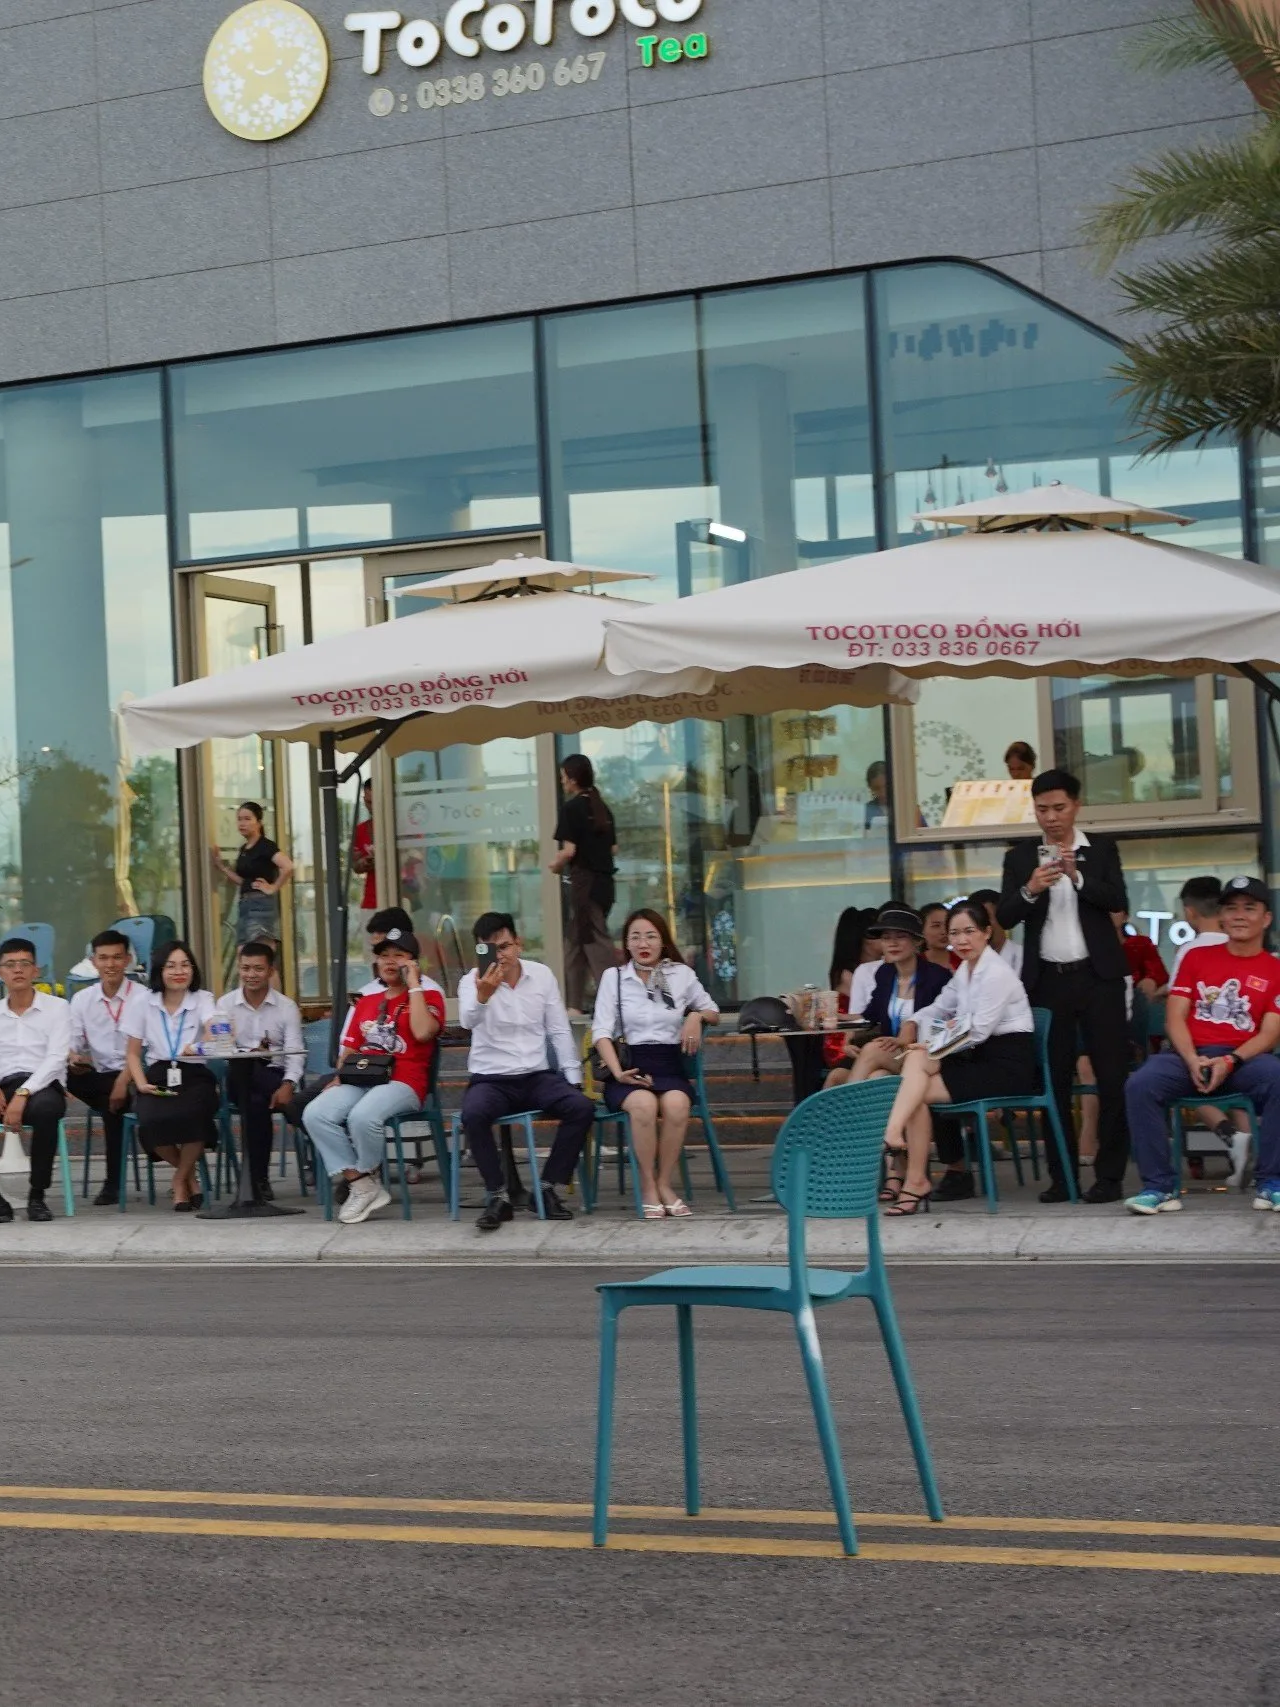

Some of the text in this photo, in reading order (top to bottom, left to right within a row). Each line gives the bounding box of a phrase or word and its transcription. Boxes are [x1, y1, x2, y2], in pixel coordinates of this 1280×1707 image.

[635, 32, 709, 68] Tea
[416, 51, 606, 110] 0338 360 667
[806, 623, 948, 641] TOCOTOCO
[847, 640, 1041, 657] ĐT: 033 836 0667
[291, 681, 415, 706] TOCOTOCO
[370, 697, 405, 712] 033
[410, 692, 444, 707] 836
[450, 687, 496, 703] 0667
